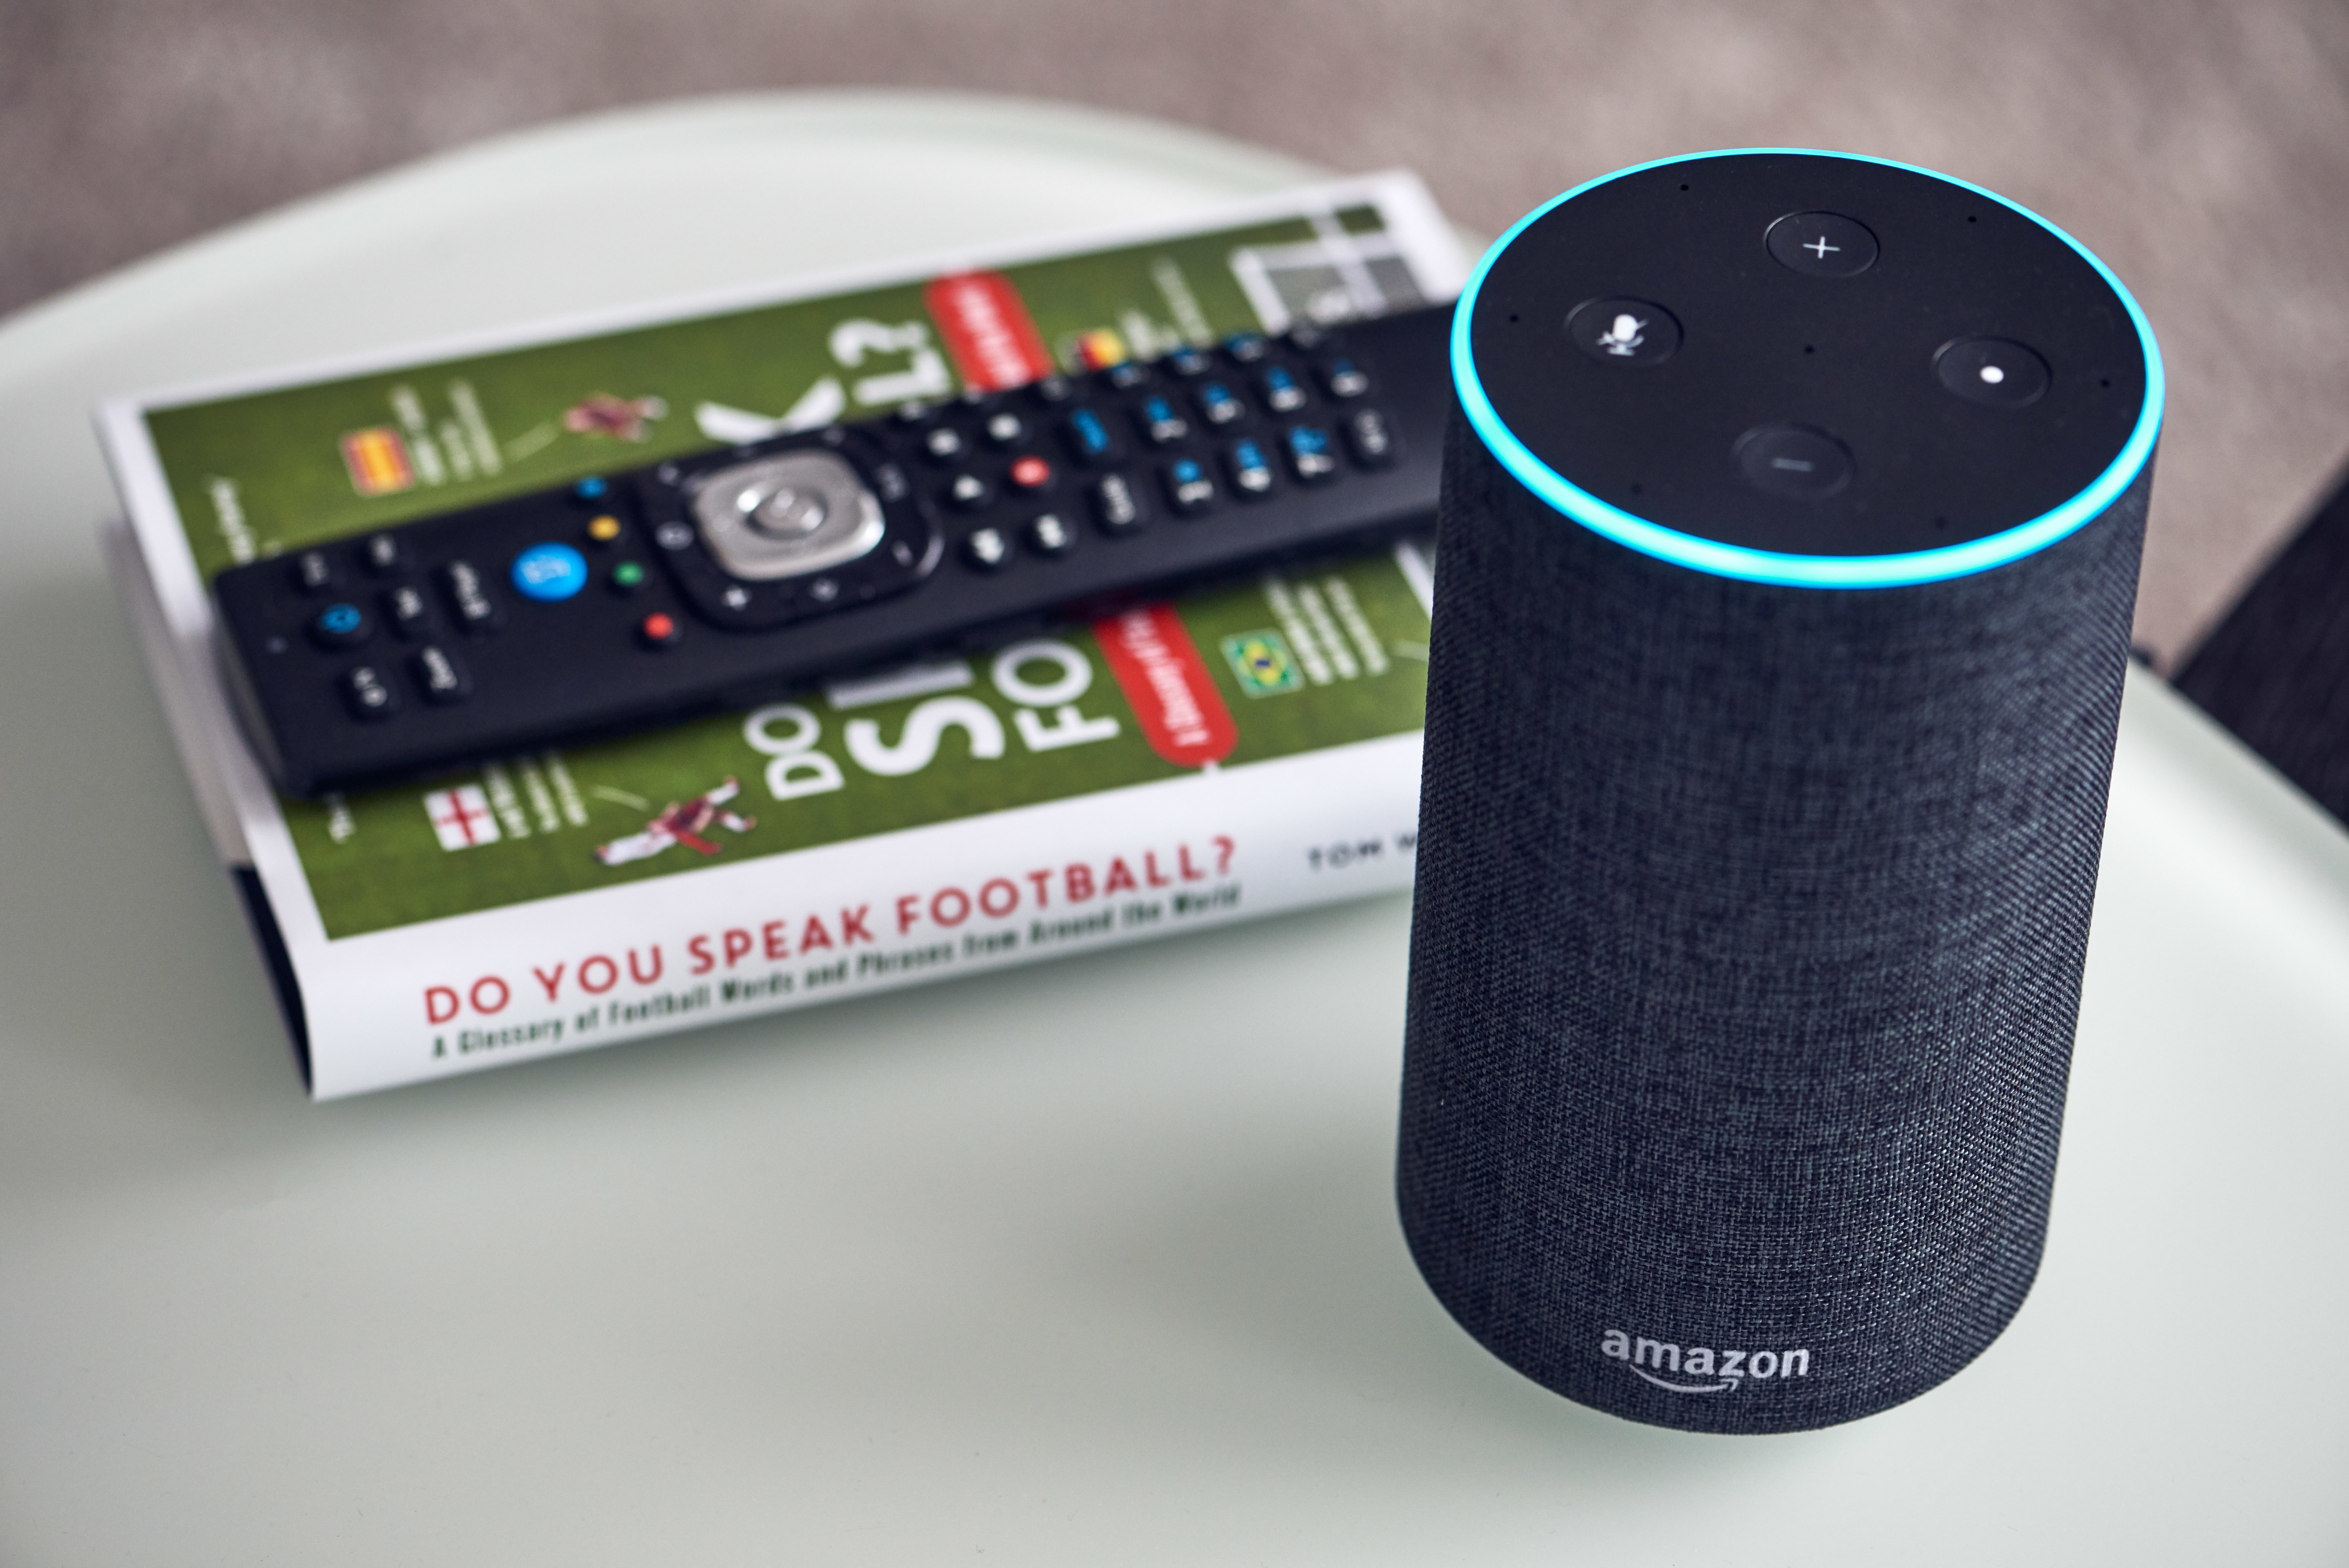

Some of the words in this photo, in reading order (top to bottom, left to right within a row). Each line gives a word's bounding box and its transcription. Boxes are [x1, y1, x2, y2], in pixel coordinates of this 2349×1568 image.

[742, 704, 845, 801] DO
[424, 975, 511, 1025] DO
[533, 944, 663, 1002] YOU
[688, 904, 874, 975] SPEAK
[894, 835, 1236, 936] FOOTBALL?
[432, 1037, 447, 1058] A
[576, 1003, 600, 1032] of
[609, 984, 709, 1026] Football
[805, 955, 849, 988] and
[1031, 909, 1111, 944] Around
[1122, 894, 1163, 927] the
[1174, 883, 1242, 917] World
[1601, 1329, 1809, 1378] amazon
